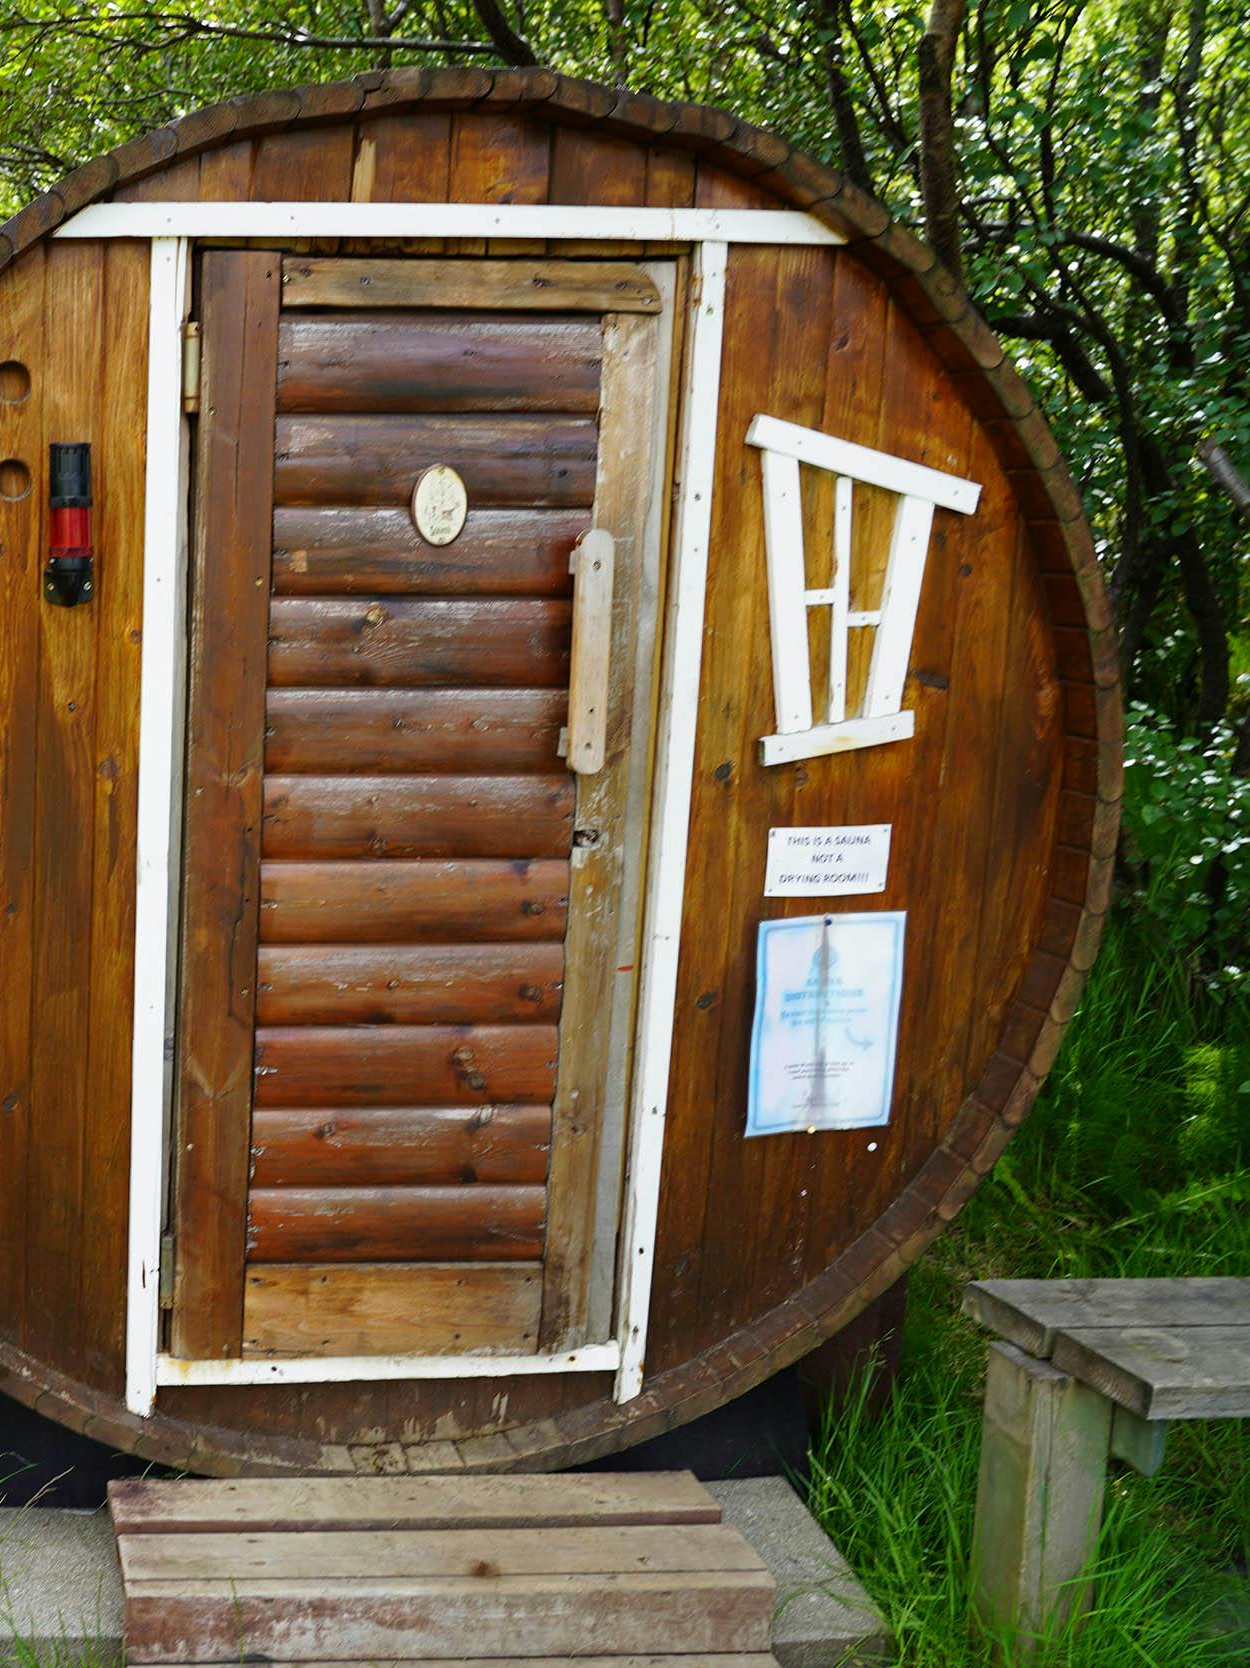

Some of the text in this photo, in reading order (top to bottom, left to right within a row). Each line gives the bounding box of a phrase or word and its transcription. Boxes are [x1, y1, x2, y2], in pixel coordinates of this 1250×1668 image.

[787, 835, 871, 846] THIS IS A SAUNA
[811, 853, 844, 863] NOT A
[779, 871, 869, 884] DRYING ROOM!!!
